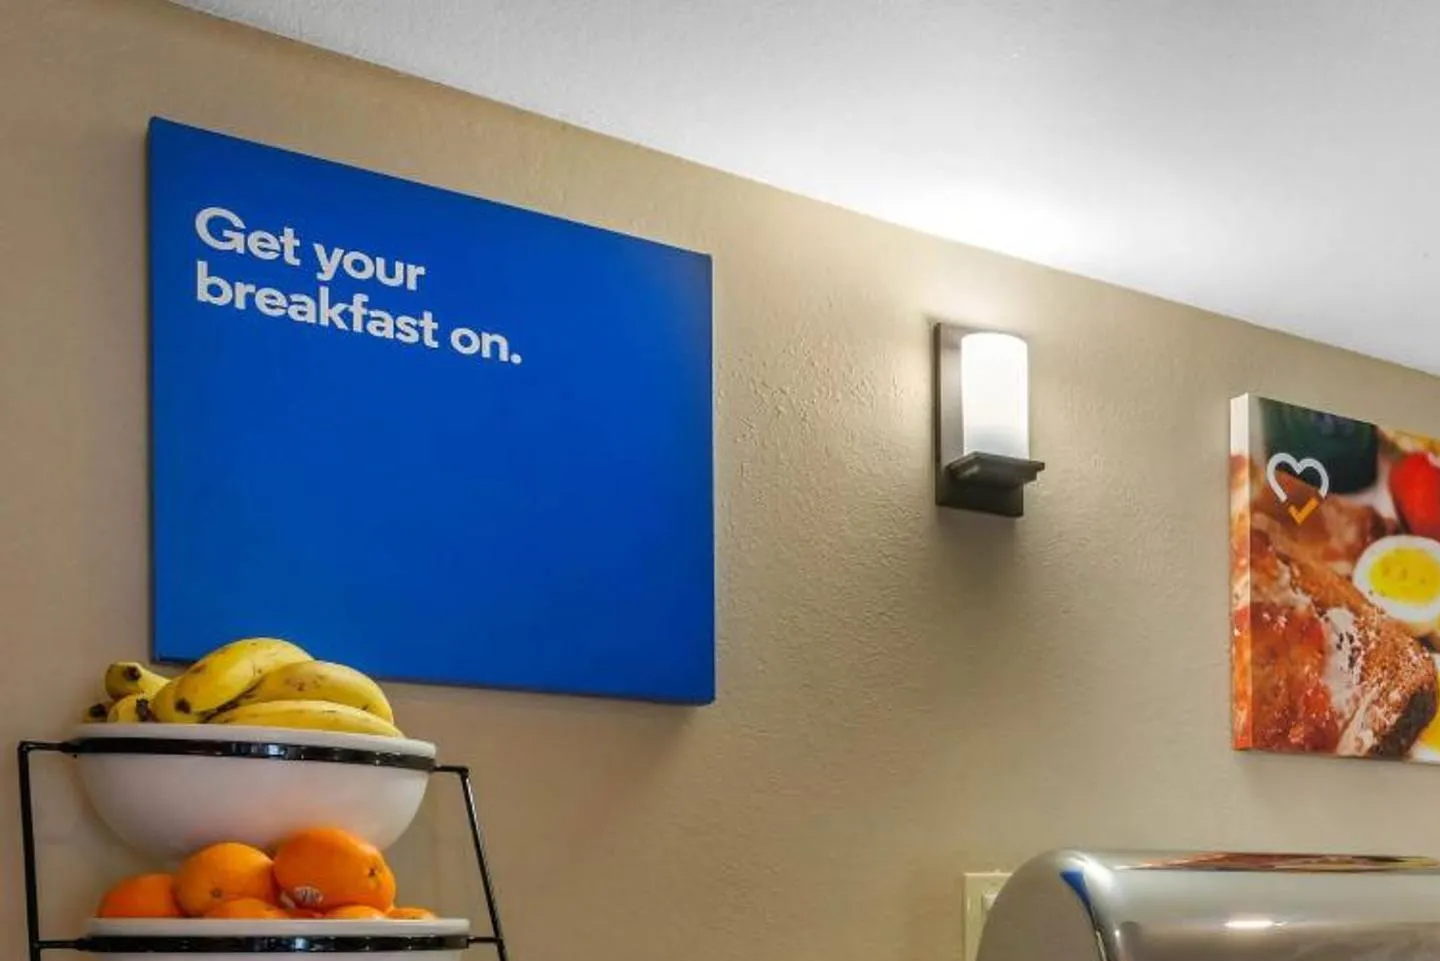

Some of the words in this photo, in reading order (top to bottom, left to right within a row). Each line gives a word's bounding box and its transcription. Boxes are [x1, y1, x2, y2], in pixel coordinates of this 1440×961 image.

[195, 206, 300, 266] Get
[313, 242, 426, 291] your
[196, 260, 439, 349] breakfast
[450, 326, 522, 364] on.
